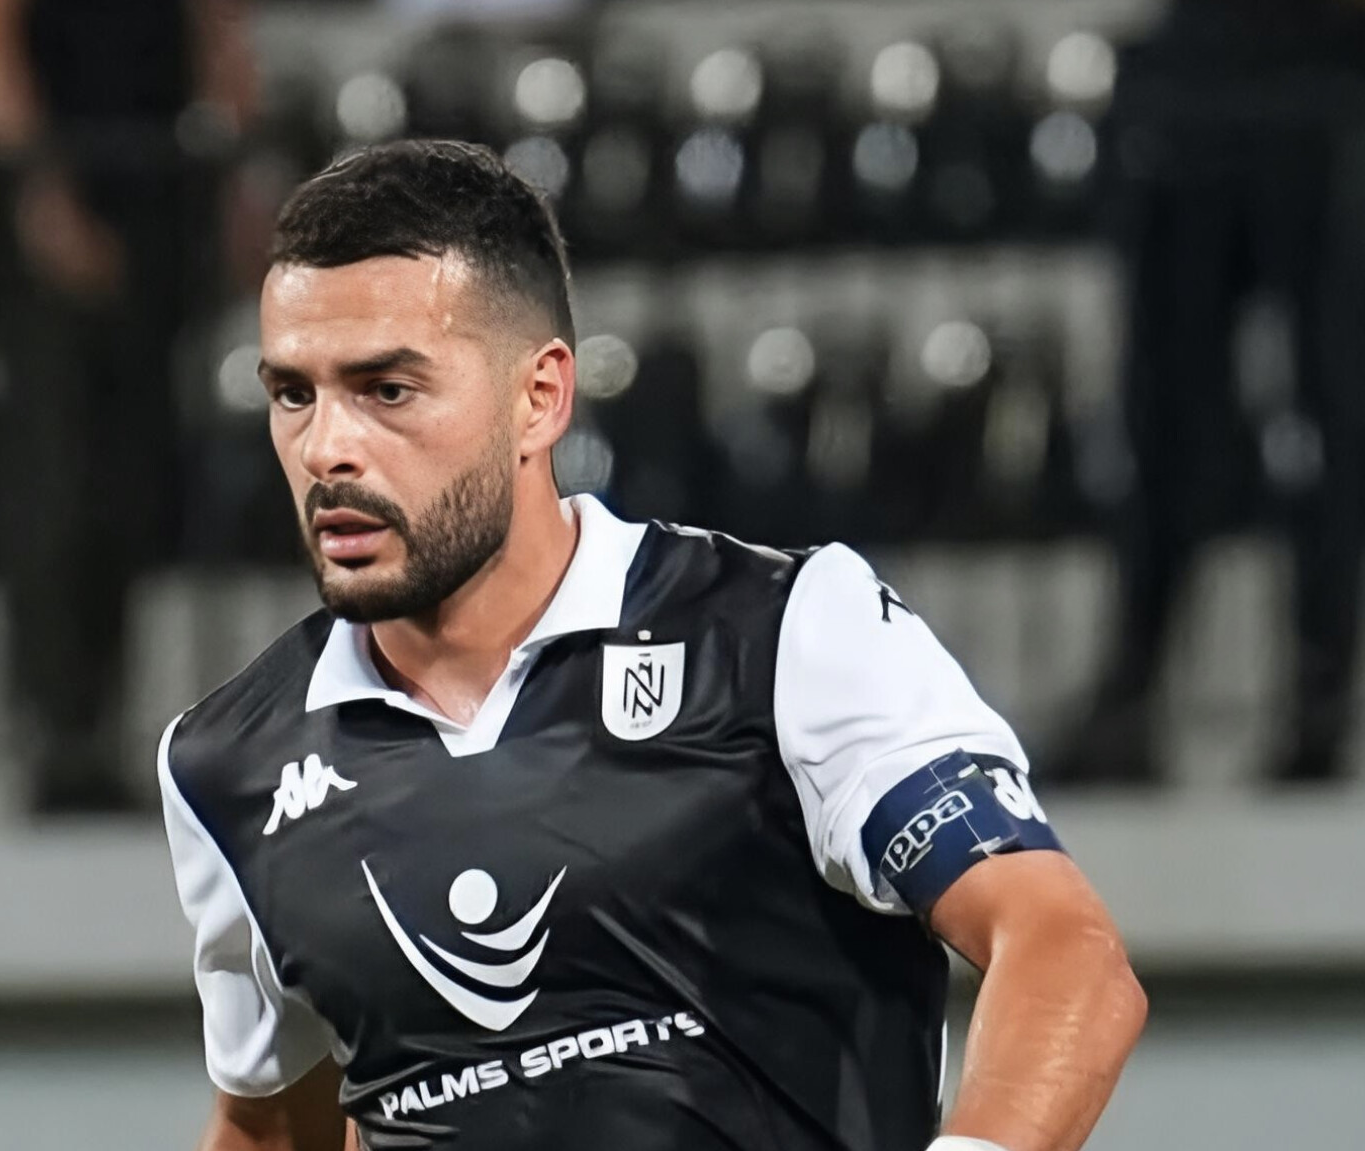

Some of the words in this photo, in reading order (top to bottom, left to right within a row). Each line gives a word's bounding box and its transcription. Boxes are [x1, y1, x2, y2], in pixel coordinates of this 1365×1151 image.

[879, 790, 973, 872] ppa
[379, 1060, 508, 1120] PALMS
[520, 1012, 704, 1077] SPORTS
